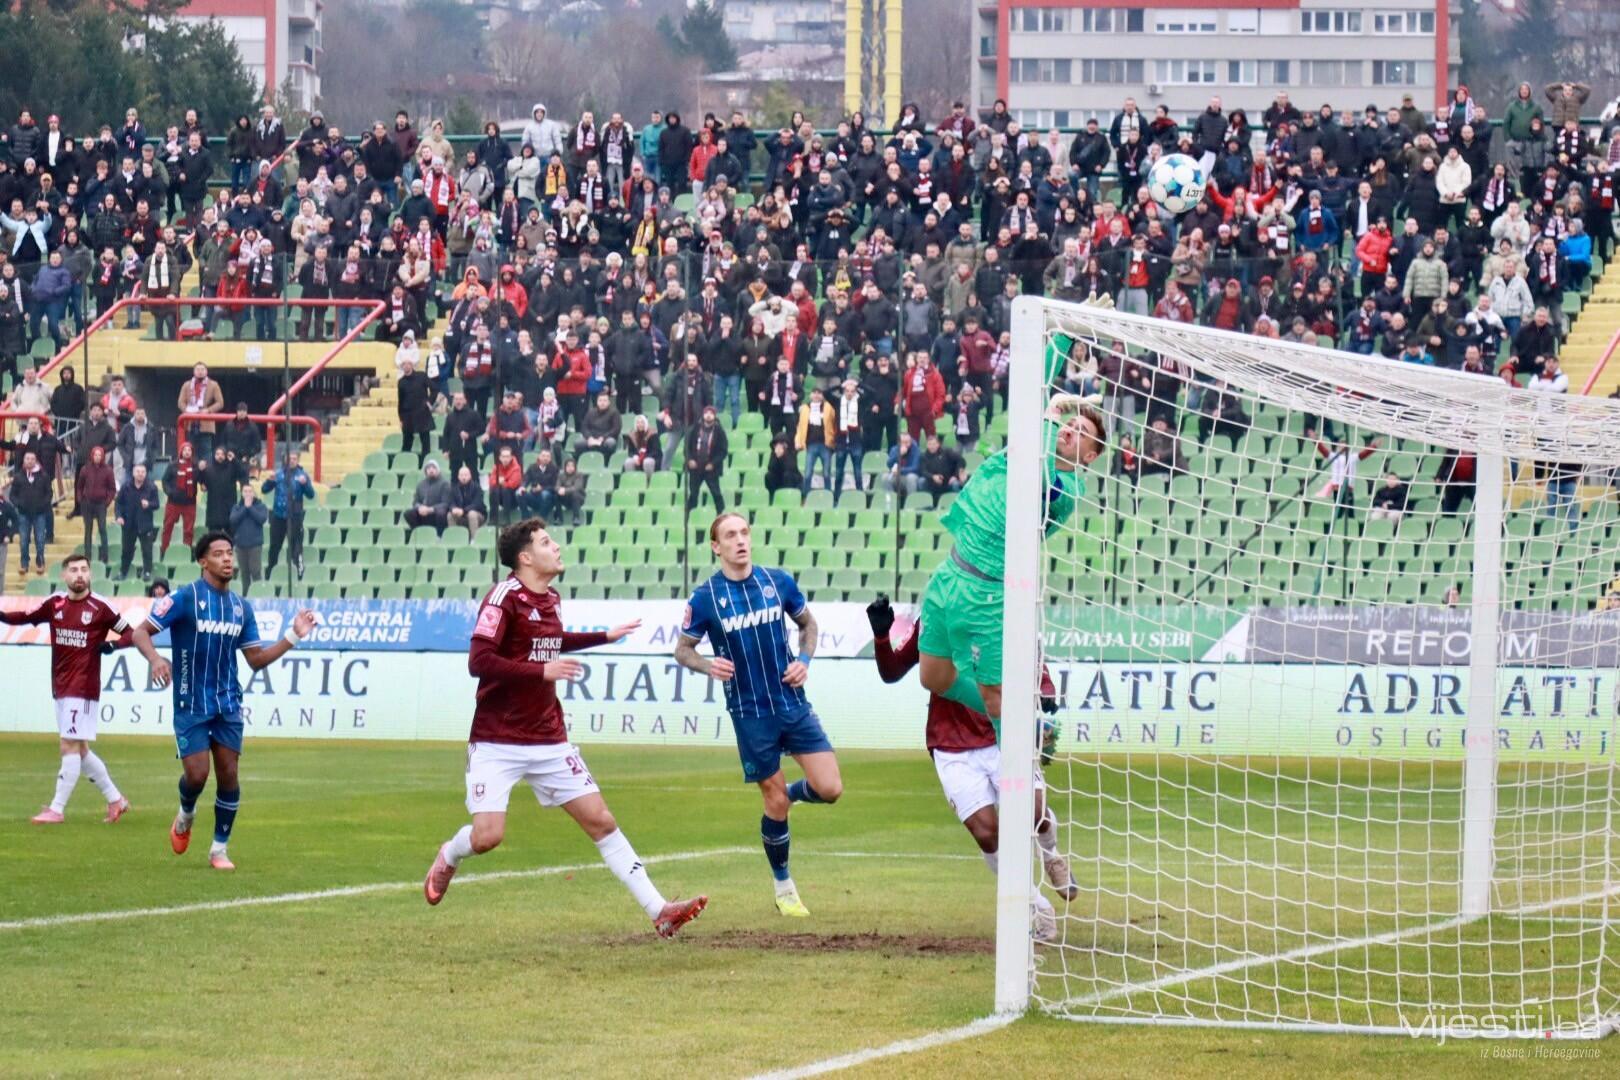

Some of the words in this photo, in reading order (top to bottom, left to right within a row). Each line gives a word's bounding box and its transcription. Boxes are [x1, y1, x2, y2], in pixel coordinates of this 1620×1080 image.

[328, 611, 413, 626] CENTRAL
[55, 628, 88, 639] TURKISH
[301, 627, 411, 642] IGURANJE
[1060, 631, 1125, 648] ZMAJA
[1131, 632, 1146, 648] U
[1149, 631, 1193, 648] SEBI
[55, 637, 87, 648] AIRLINES
[532, 636, 563, 649] TURKIS
[1366, 629, 1537, 658] REFOM
[528, 650, 561, 663] AIRLIN
[102, 654, 370, 697] ADATIC
[563, 662, 717, 703] RIATI
[1058, 670, 1217, 711] IATIC
[1337, 672, 1620, 718] ADRATI
[70, 709, 79, 724] 7
[100, 703, 367, 731] OSIRANJE
[1336, 726, 1608, 755] OSIGRANJ
